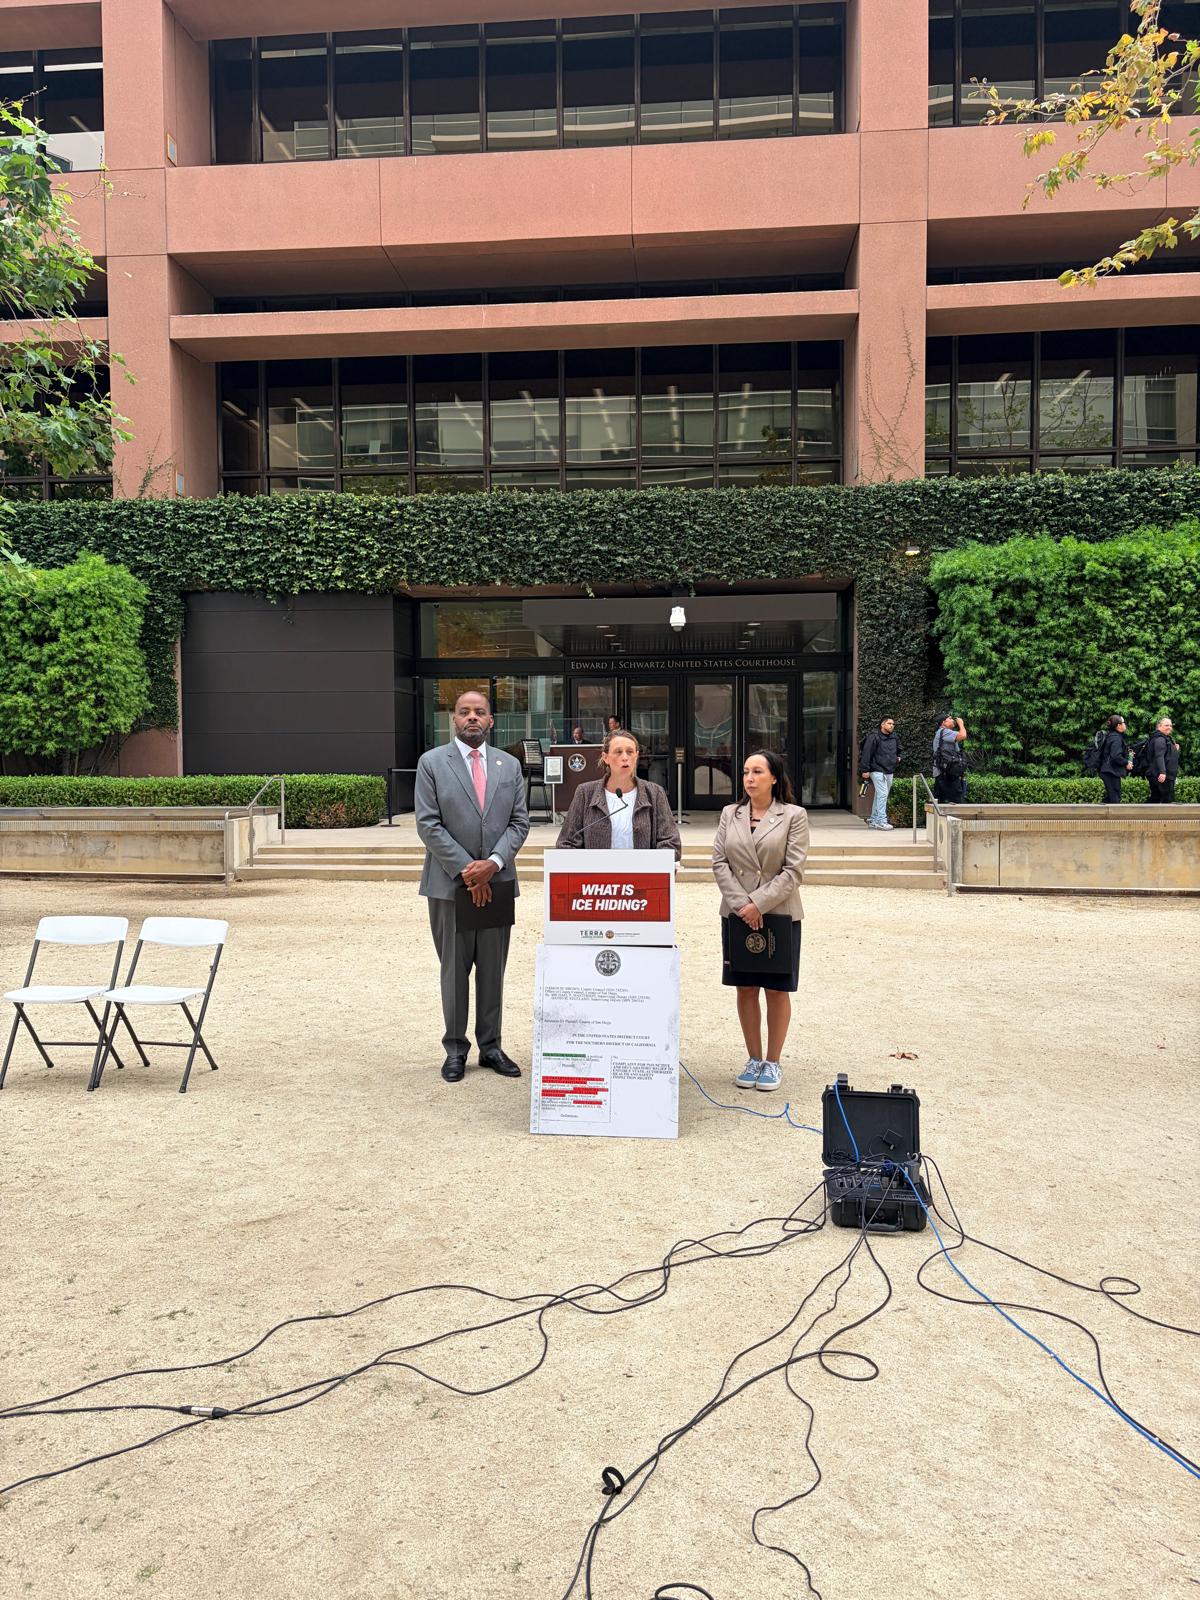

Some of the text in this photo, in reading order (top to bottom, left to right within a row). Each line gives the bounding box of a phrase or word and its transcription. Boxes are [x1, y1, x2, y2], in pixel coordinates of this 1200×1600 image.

[571, 661, 608, 670] EDWARD
[611, 661, 617, 670] J.
[619, 660, 665, 669] SCHWARTZ
[667, 660, 701, 668] UNITED
[704, 660, 733, 668] STATES
[582, 884, 634, 896] WHAT IS
[572, 899, 648, 910] ICE HIDING?
